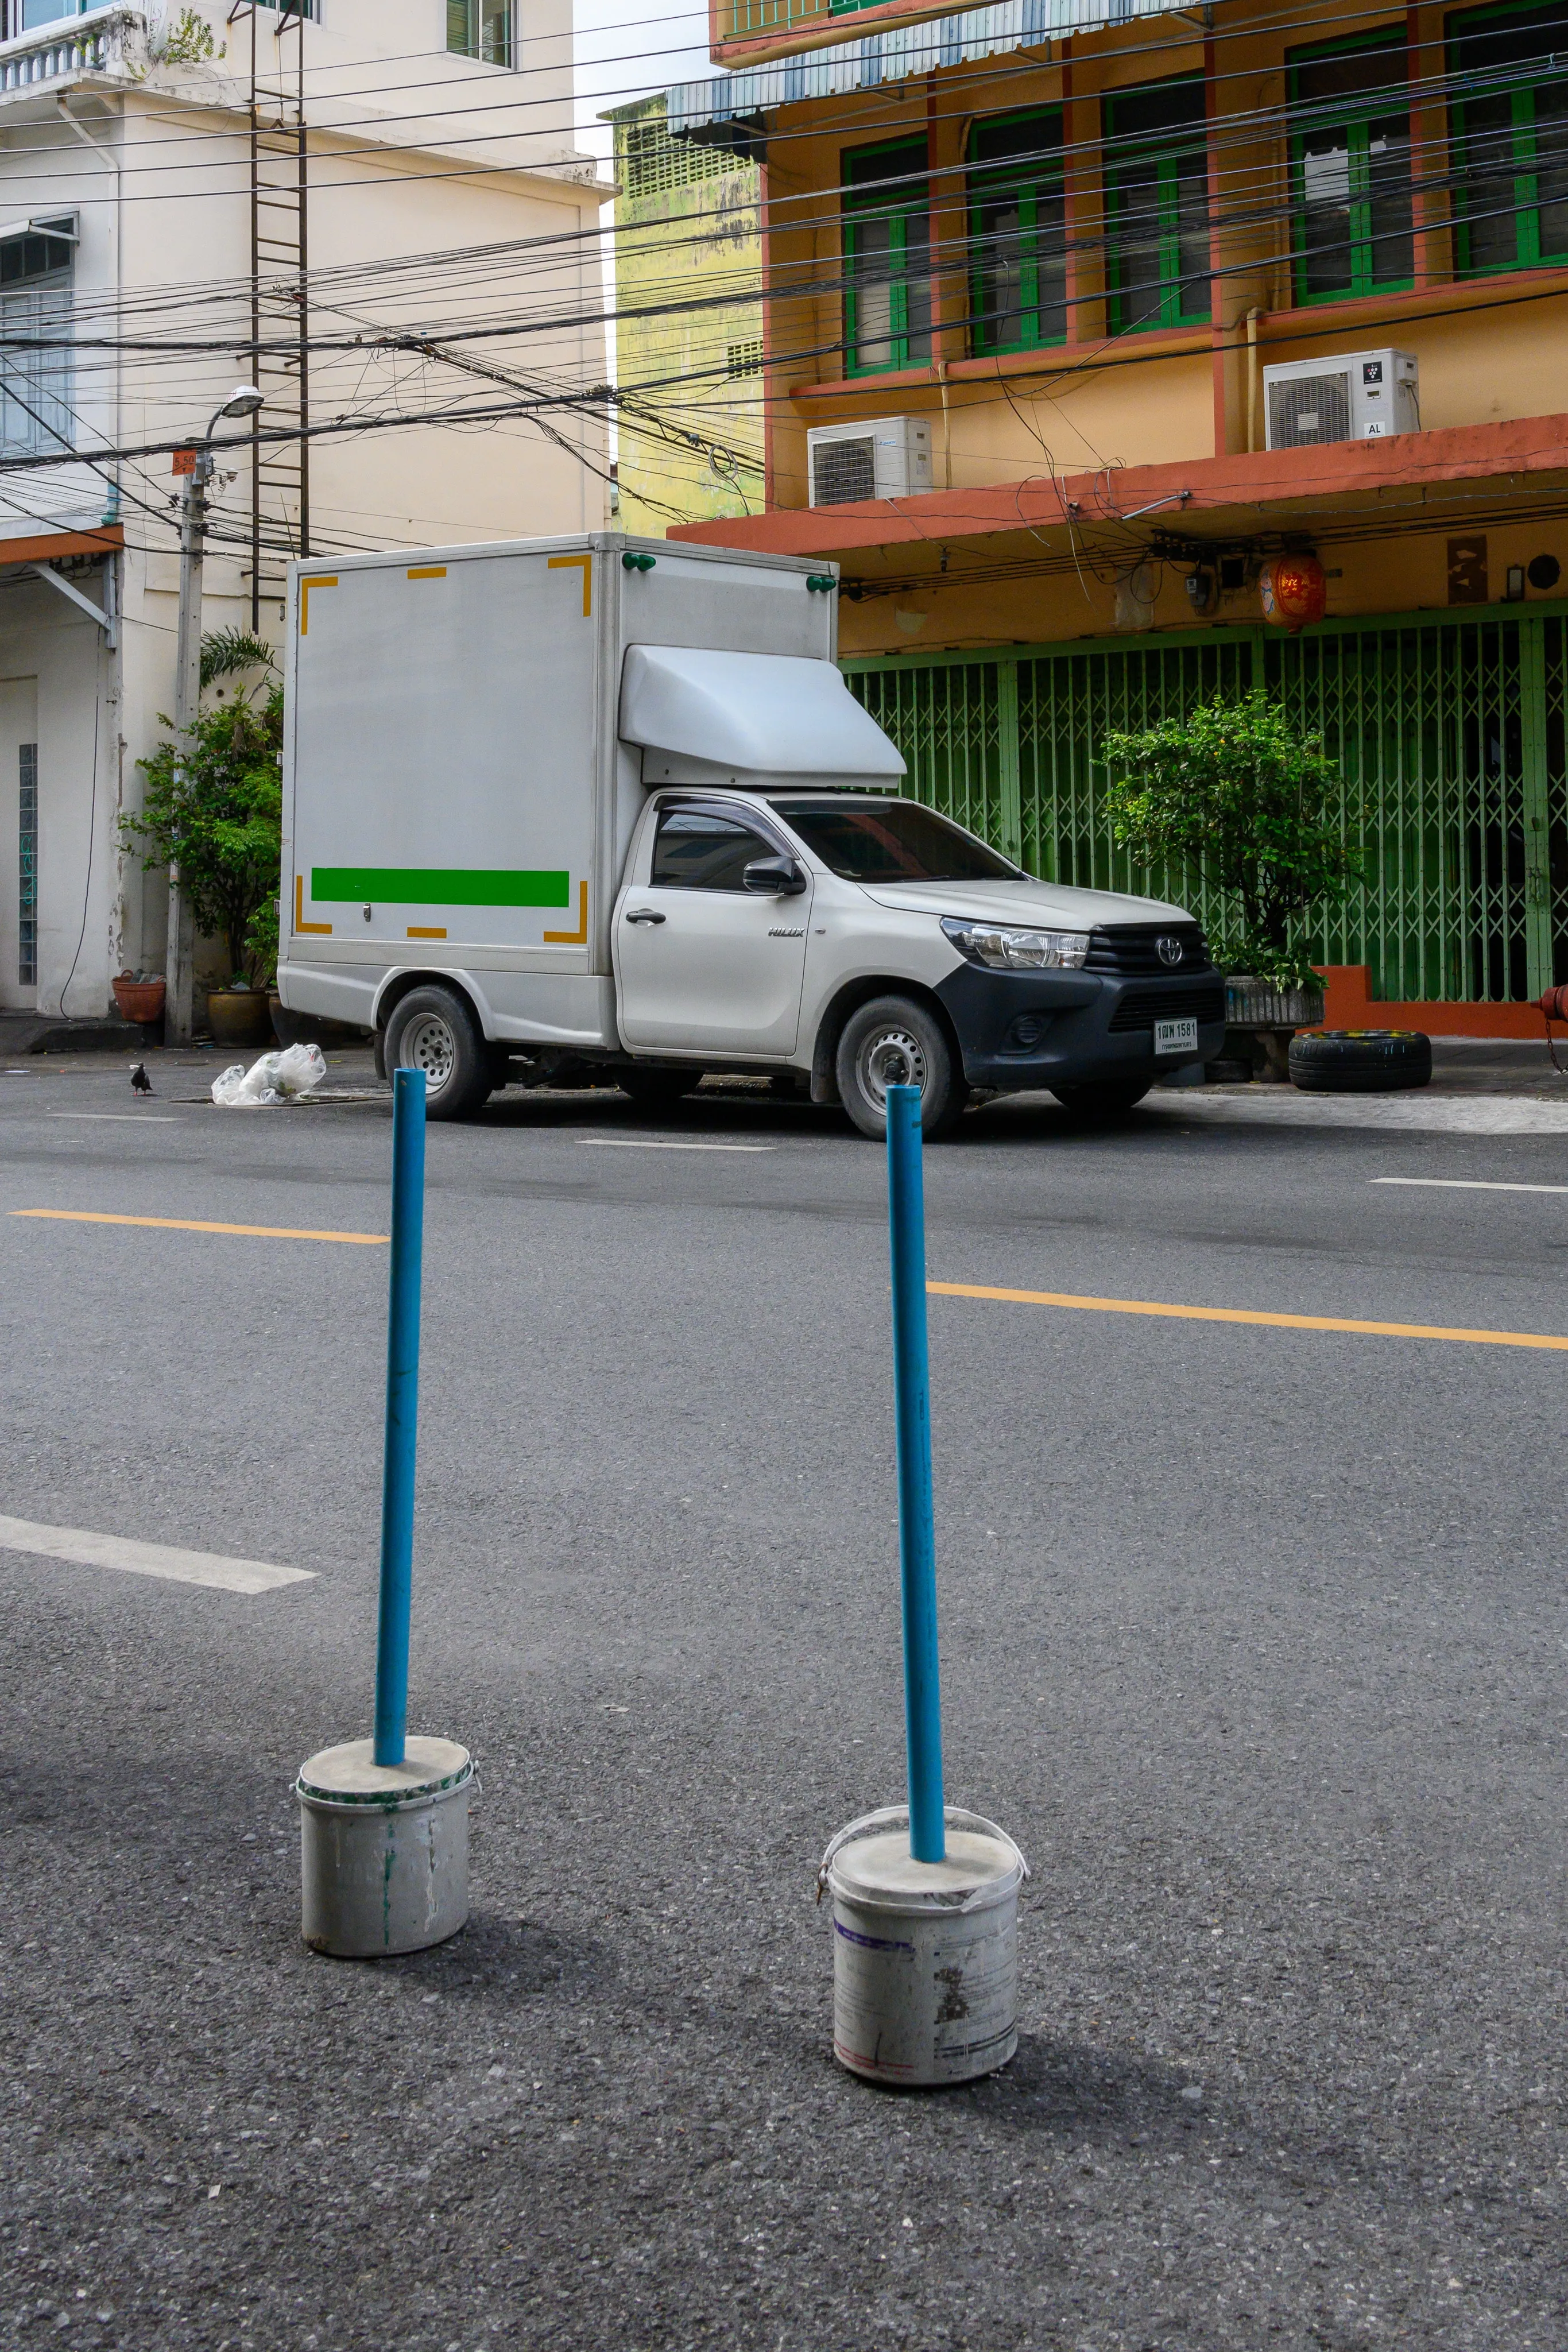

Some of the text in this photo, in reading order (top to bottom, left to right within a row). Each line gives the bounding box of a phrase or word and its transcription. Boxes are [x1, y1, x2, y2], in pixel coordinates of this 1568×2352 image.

[1369, 424, 1381, 434] AL
[768, 927, 805, 937] HILUX
[1176, 1022, 1195, 1038] 1581
